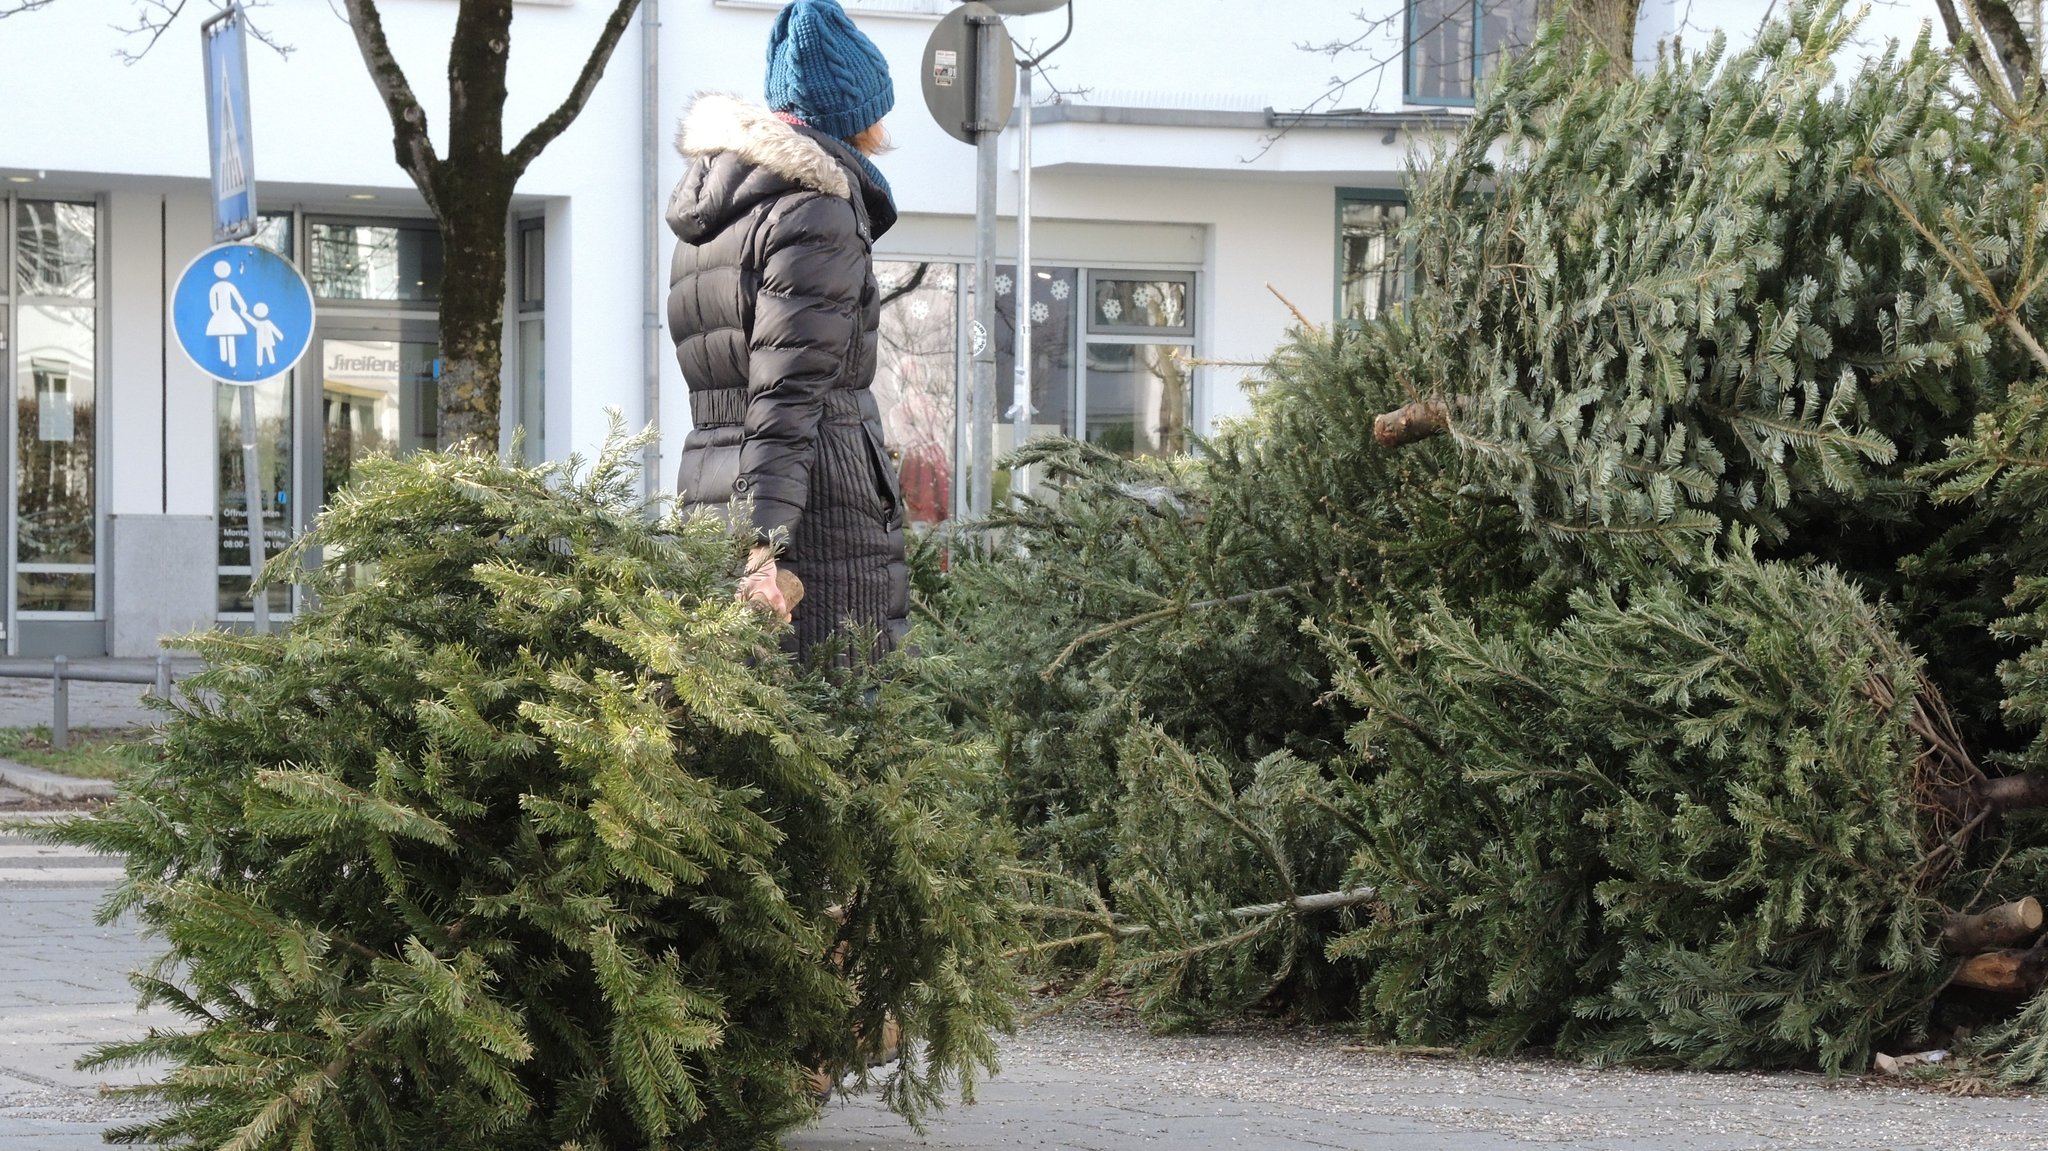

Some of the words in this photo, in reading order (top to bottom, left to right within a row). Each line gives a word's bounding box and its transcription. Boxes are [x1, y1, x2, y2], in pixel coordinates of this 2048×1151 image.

[223, 529, 249, 537] Monta
[264, 529, 286, 538] reitag
[271, 540, 286, 549] Uhr
